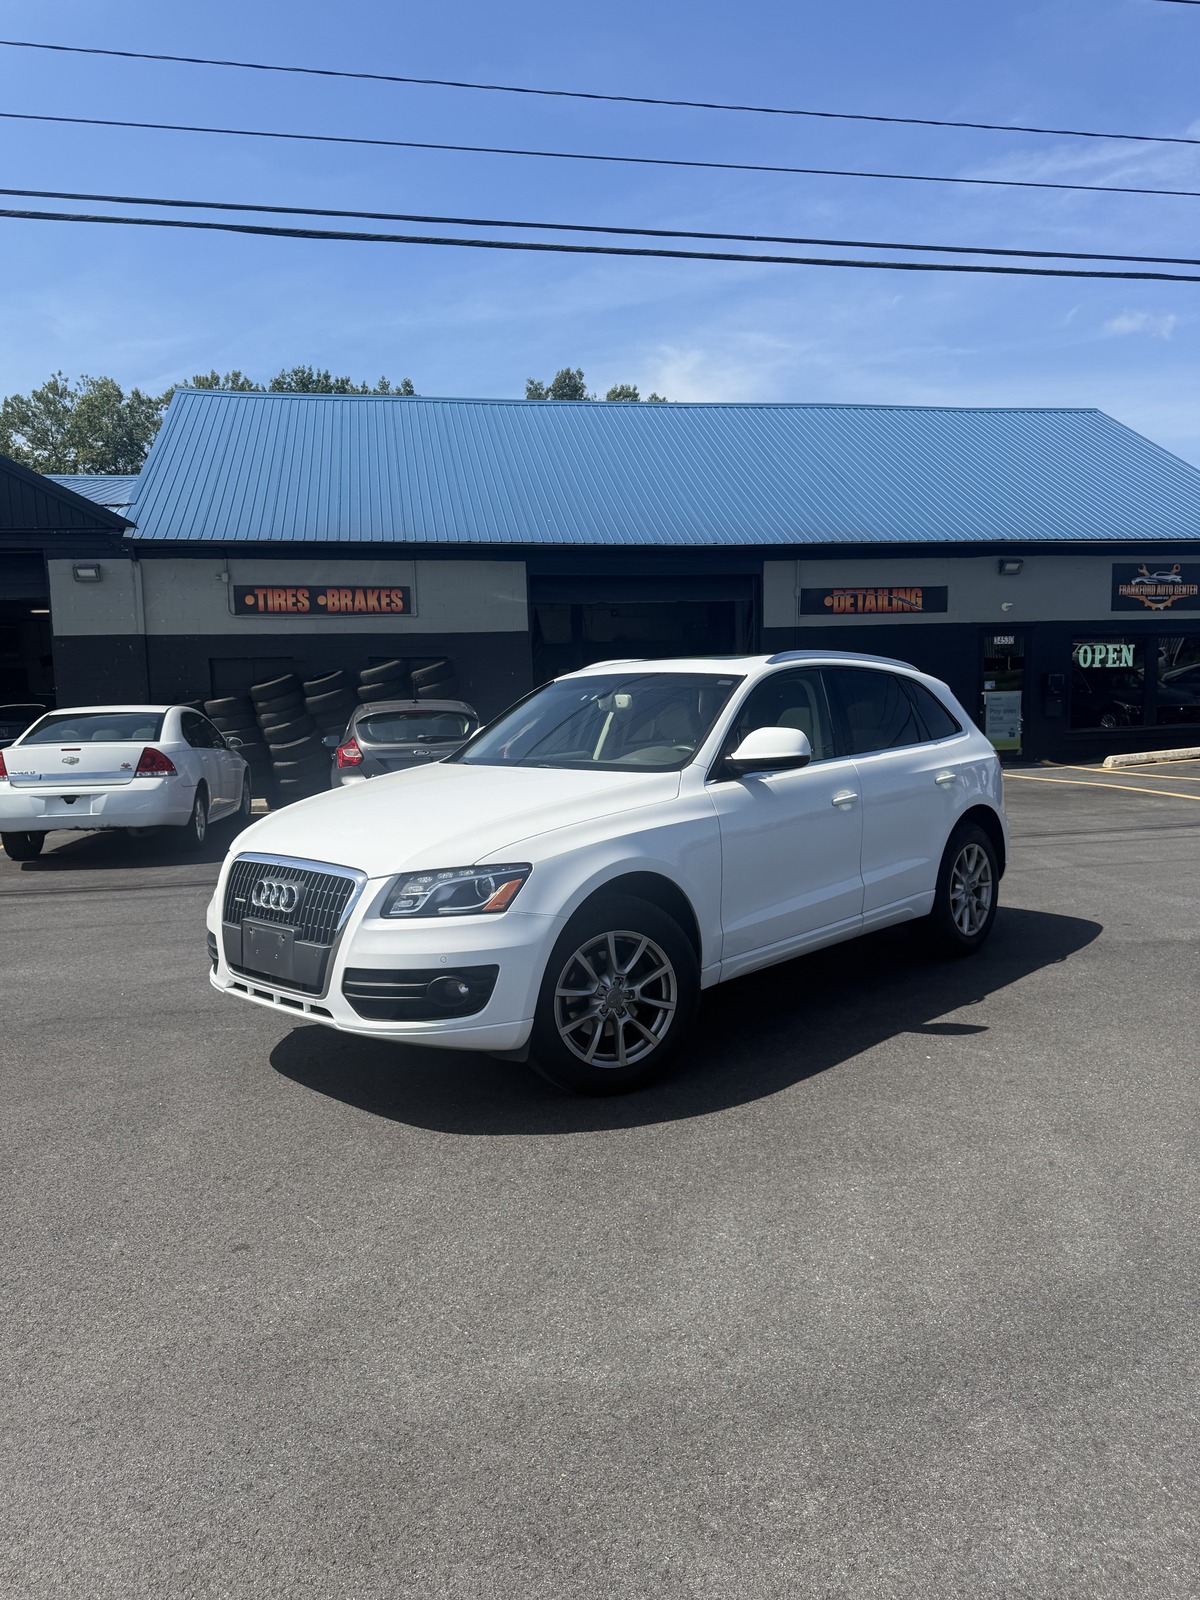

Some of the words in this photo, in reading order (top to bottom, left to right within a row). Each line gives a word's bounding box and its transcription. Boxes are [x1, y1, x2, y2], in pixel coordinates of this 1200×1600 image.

[254, 588, 310, 612] TIRES
[326, 588, 404, 612] BRAKES
[833, 588, 923, 612] DETAILING
[1119, 584, 1156, 595] FRANKFORD
[1156, 584, 1173, 595] AUTO
[1173, 584, 1198, 595] CENTER
[1078, 644, 1136, 669] OPEN
[989, 708, 1002, 716] Pay
